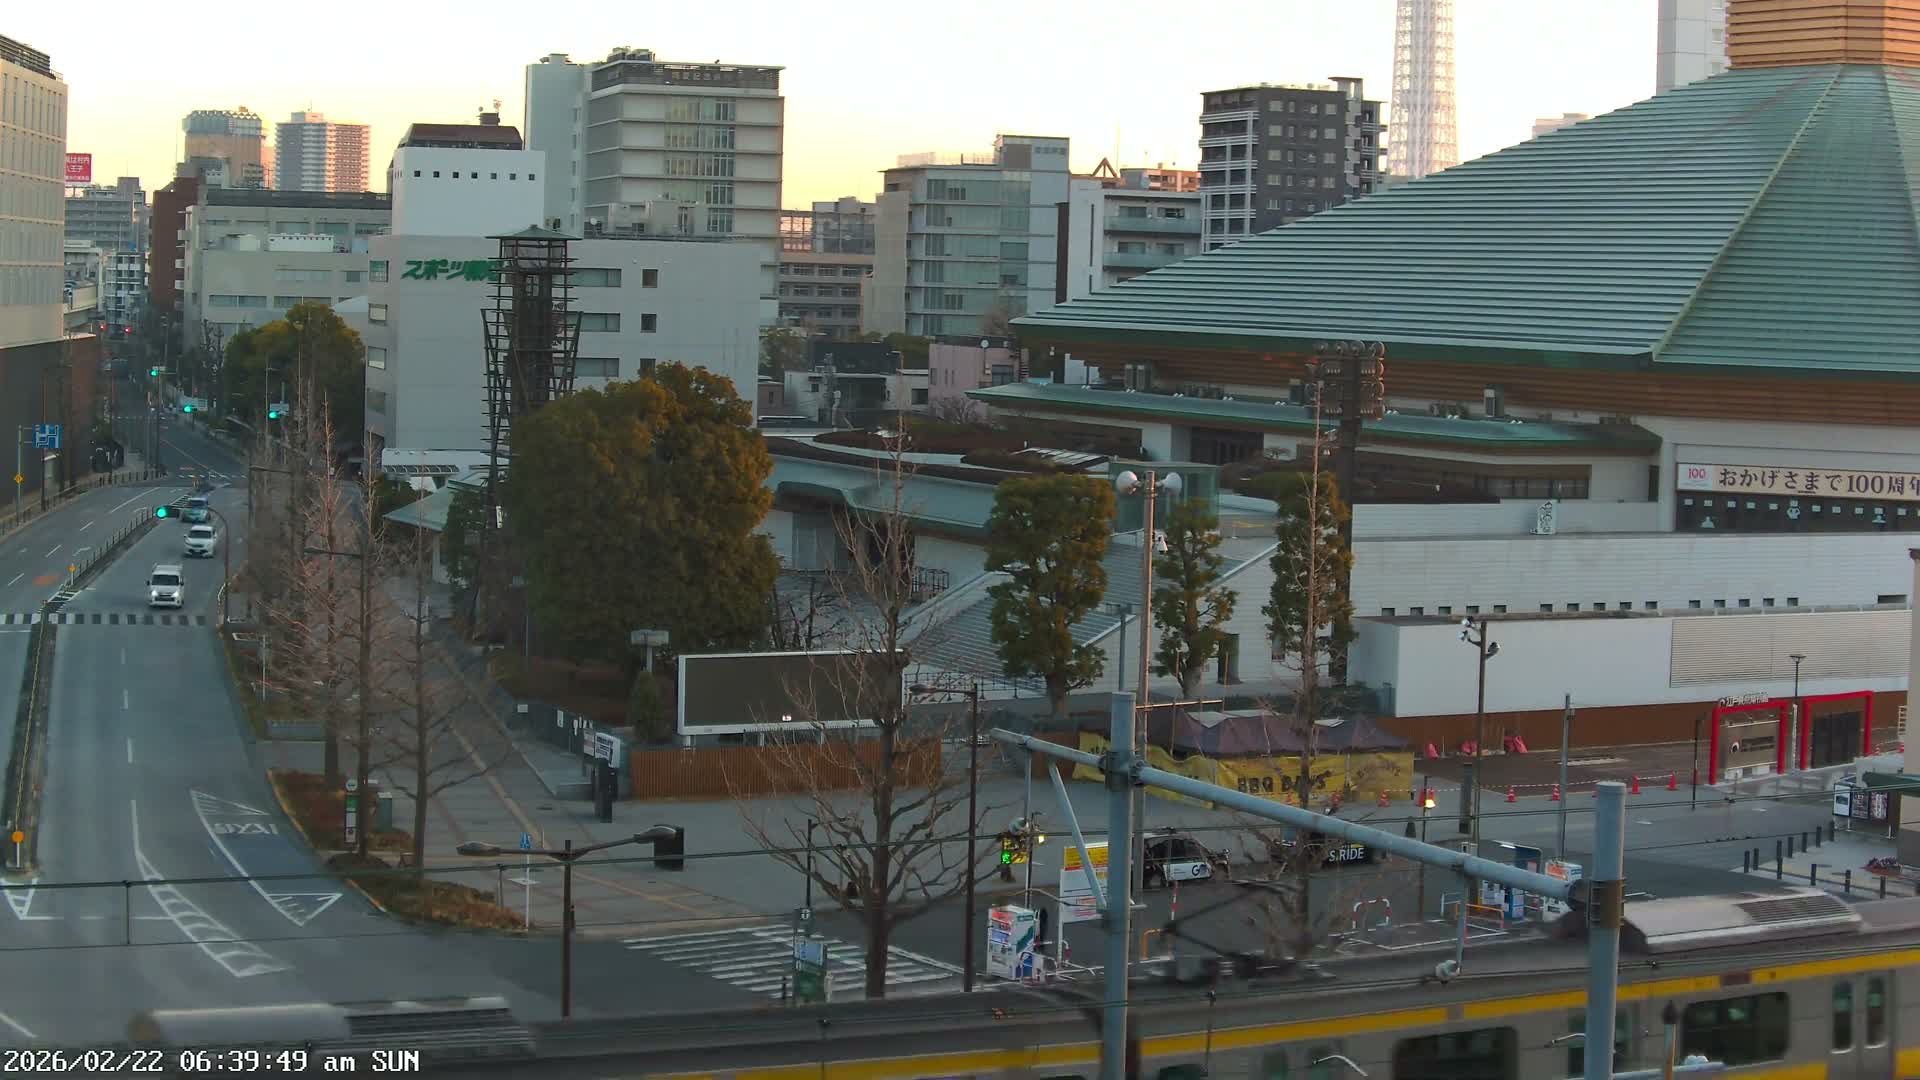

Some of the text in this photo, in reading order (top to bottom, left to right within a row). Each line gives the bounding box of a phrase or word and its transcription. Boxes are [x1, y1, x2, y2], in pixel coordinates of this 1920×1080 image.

[1688, 468, 1706, 479] 100
[1719, 467, 1920, 496] おかげさまで100周年
